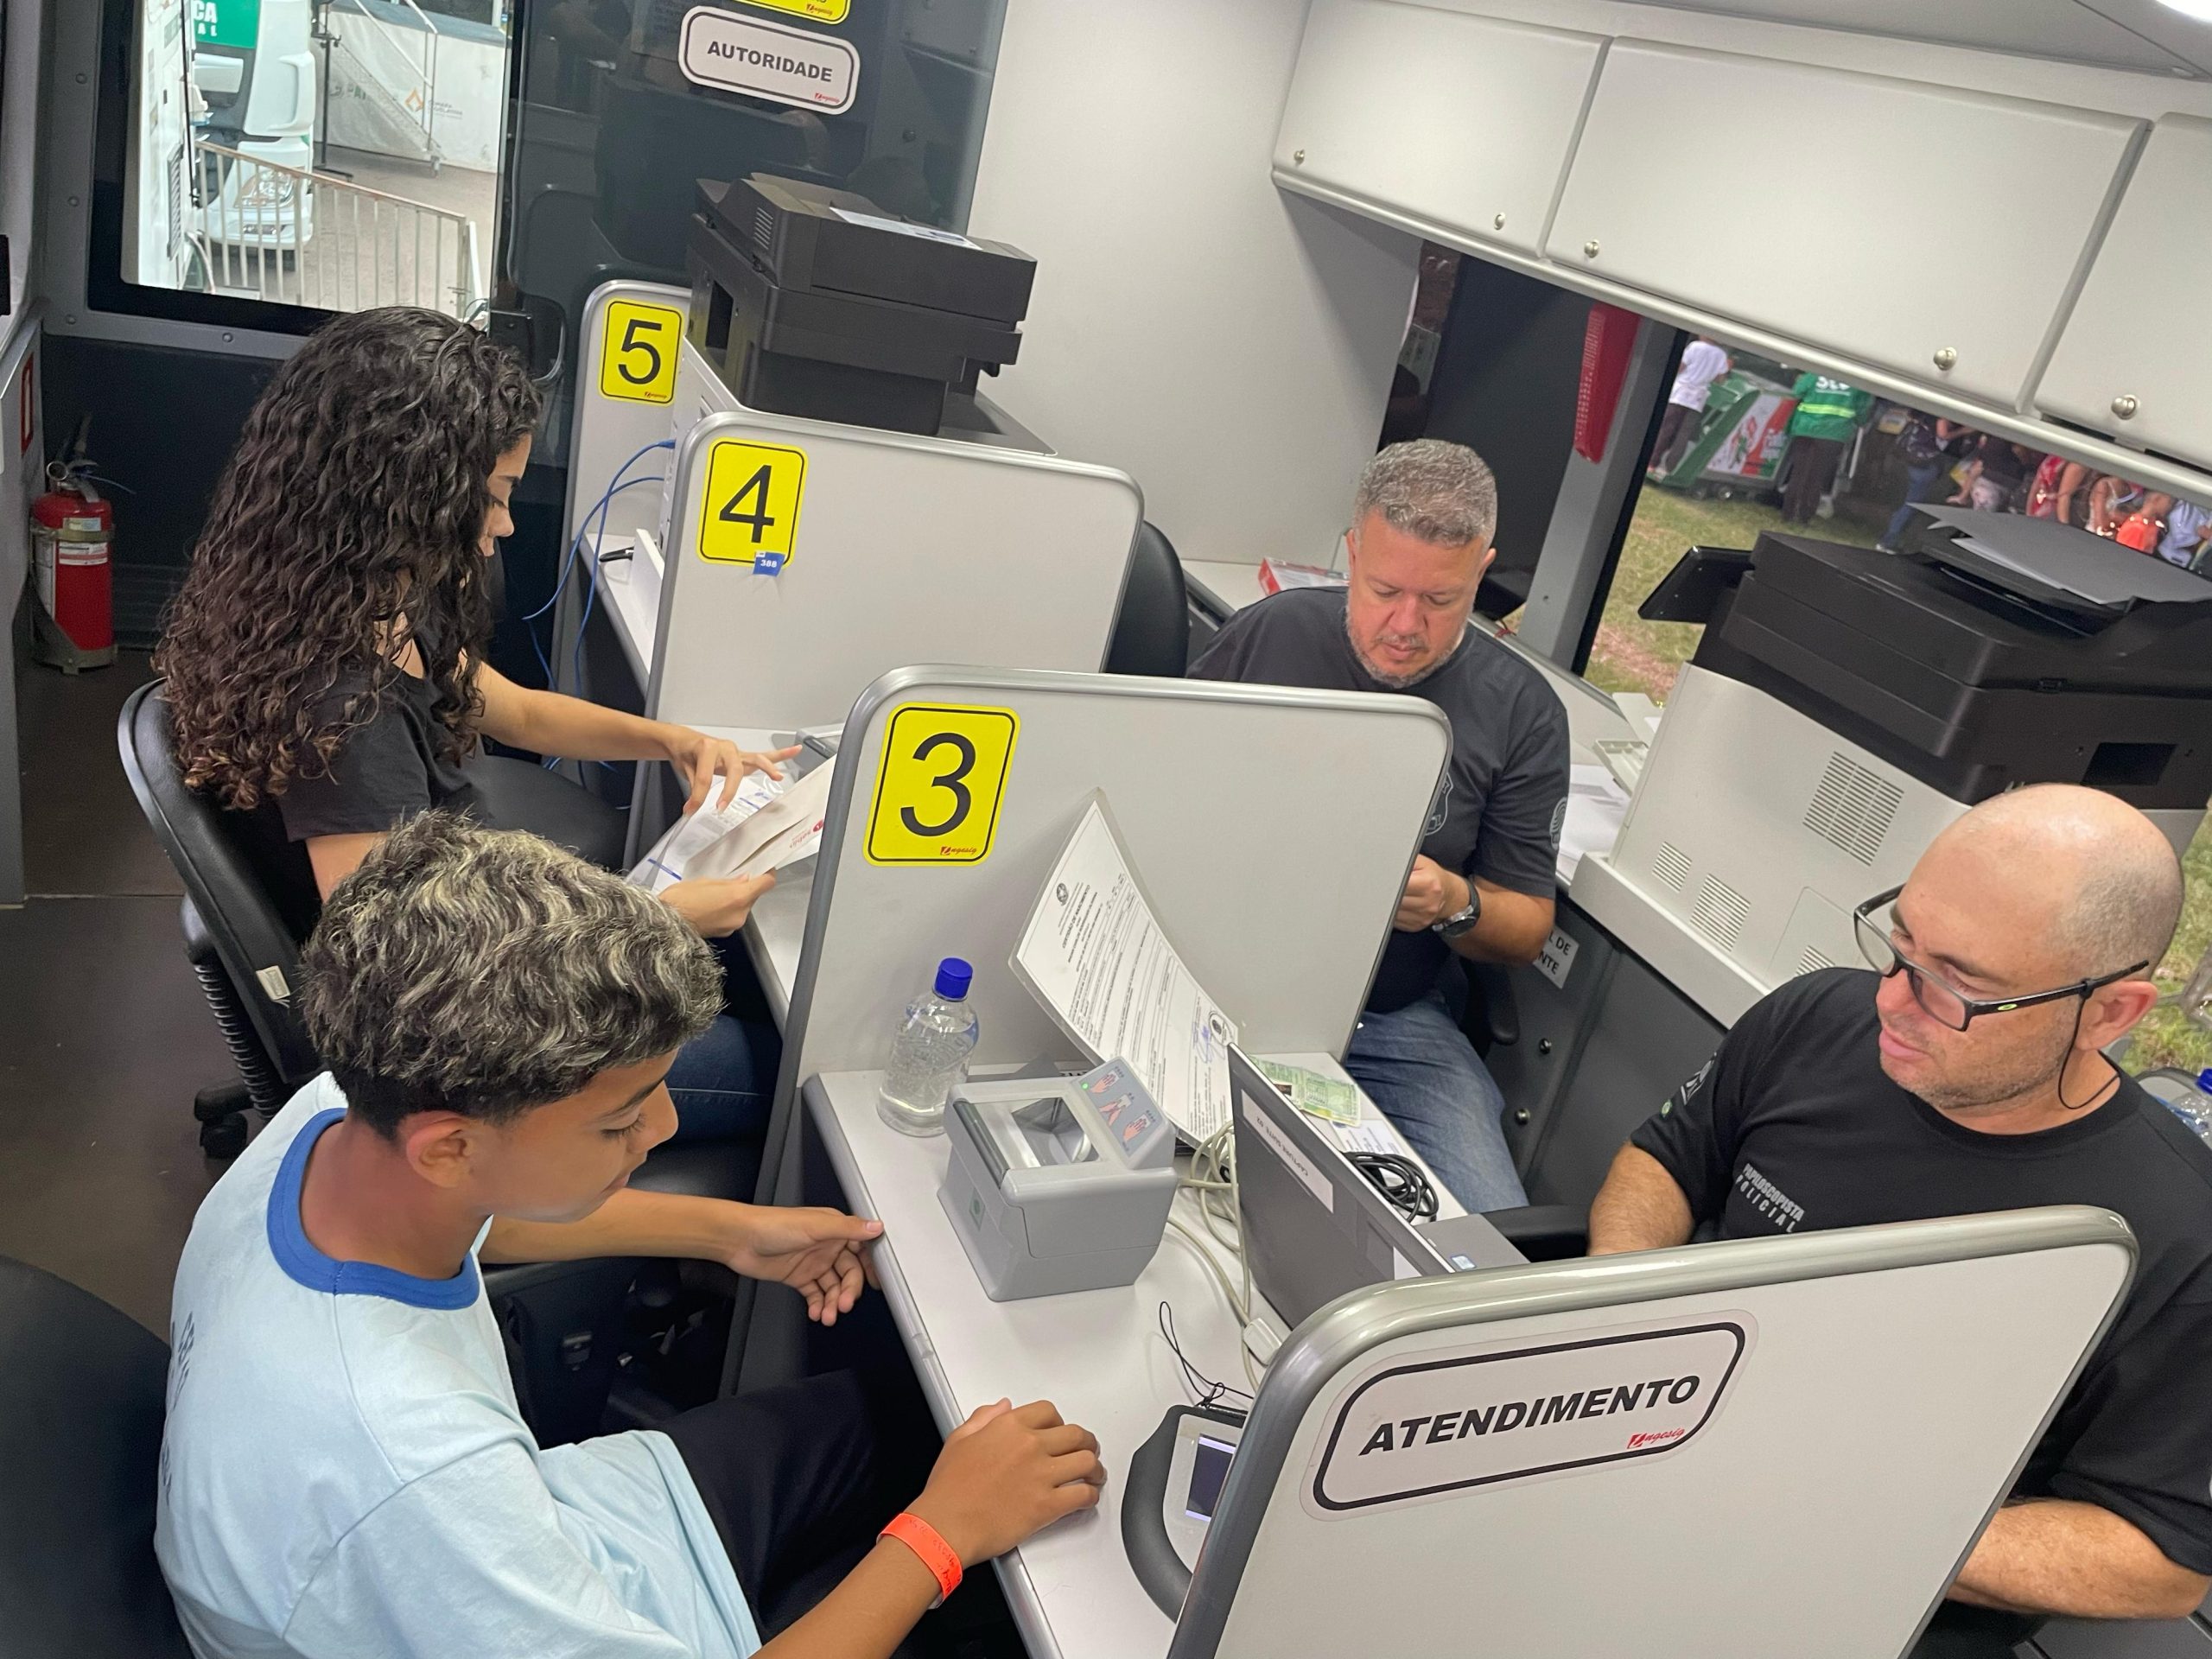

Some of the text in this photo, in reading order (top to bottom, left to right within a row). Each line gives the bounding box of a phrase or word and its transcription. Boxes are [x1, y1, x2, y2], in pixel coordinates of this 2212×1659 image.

[707, 41, 833, 82] AUTORIDADE
[618, 319, 663, 385] 5
[719, 464, 775, 543] 4
[900, 732, 976, 836] 3
[1555, 937, 1572, 956] DE
[1736, 1175, 1796, 1233] POLICIAL
[1358, 1376, 1700, 1456] ATENDIMENTO
